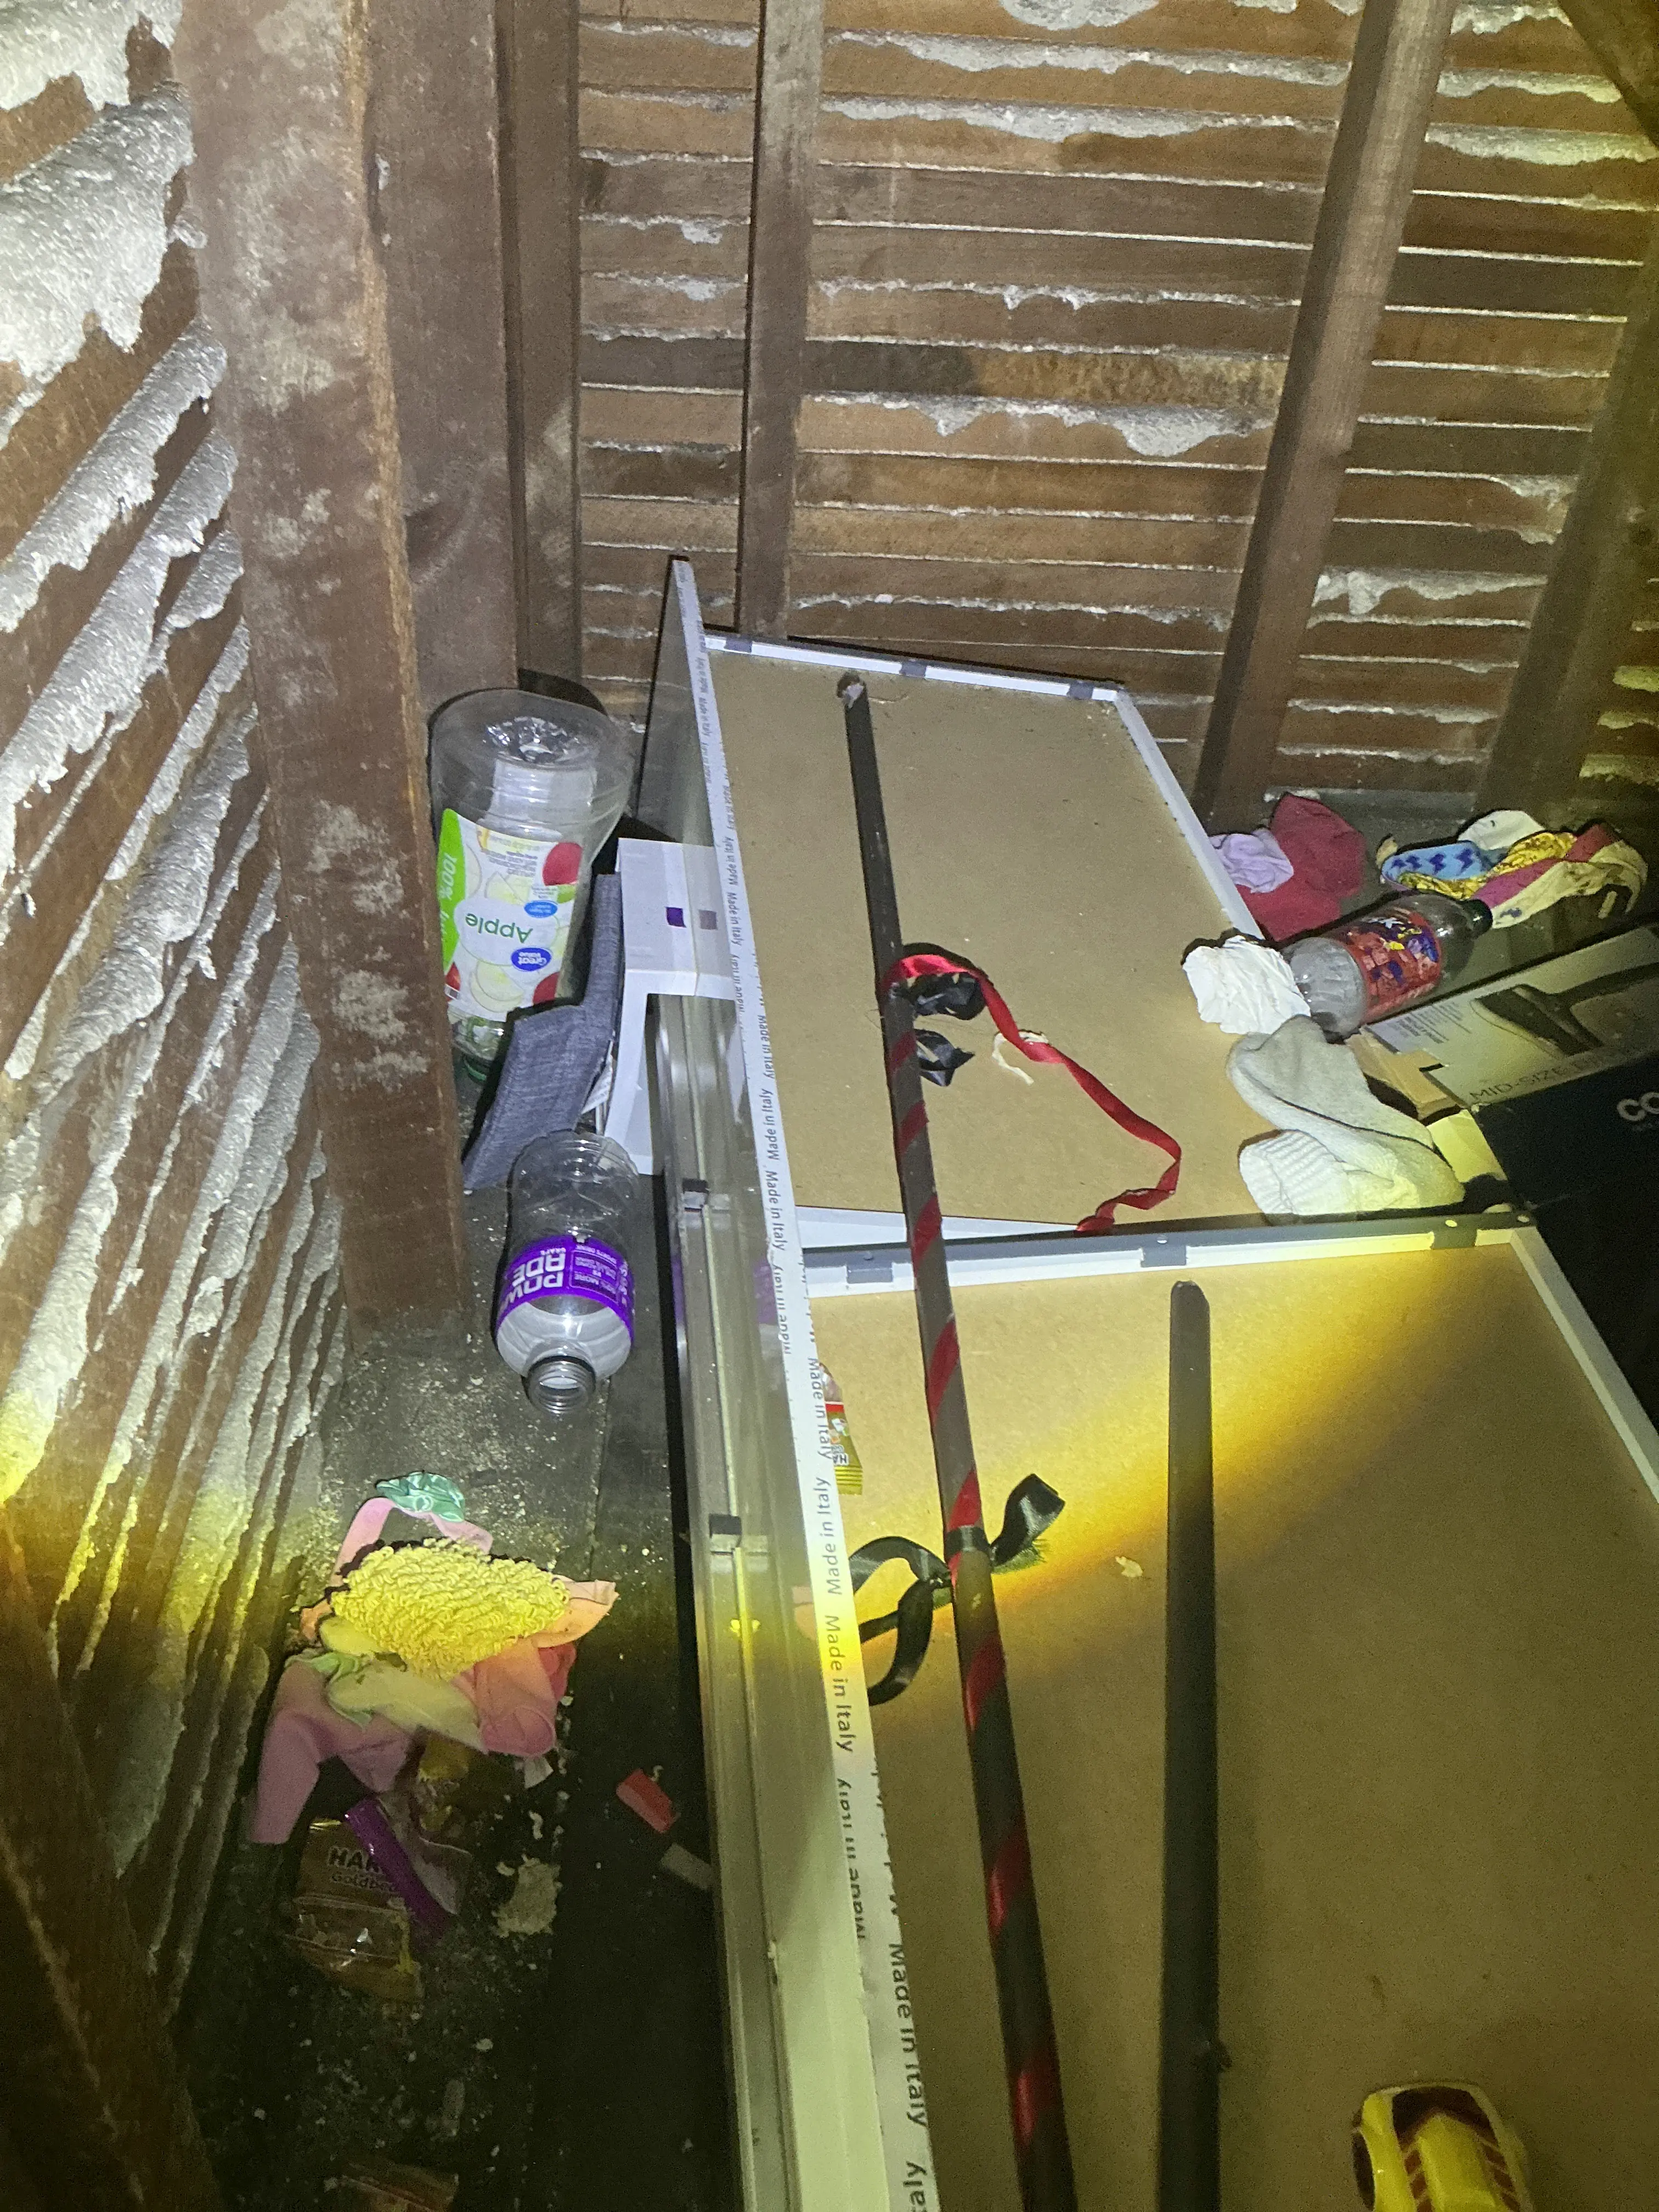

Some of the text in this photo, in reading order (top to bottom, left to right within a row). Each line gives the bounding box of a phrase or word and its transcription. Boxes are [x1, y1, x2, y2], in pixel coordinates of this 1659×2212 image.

[723, 836, 735, 854] Italy
[439, 853, 458, 901] 100%
[726, 863, 738, 886] Made
[726, 891, 740, 915] Made
[465, 913, 533, 943] Apple
[731, 927, 746, 946] Italy
[518, 956, 547, 966] Great
[759, 1088, 780, 1160] Made in Italy
[765, 1170, 788, 1251] Made in Italy
[512, 1253, 566, 1288] ADE
[808, 1357, 833, 1460] Made in Italy
[812, 1476, 842, 1595] Made in Italy
[825, 1615, 856, 1753] Made in Italy
[888, 1943, 928, 2127] Made in Italy
